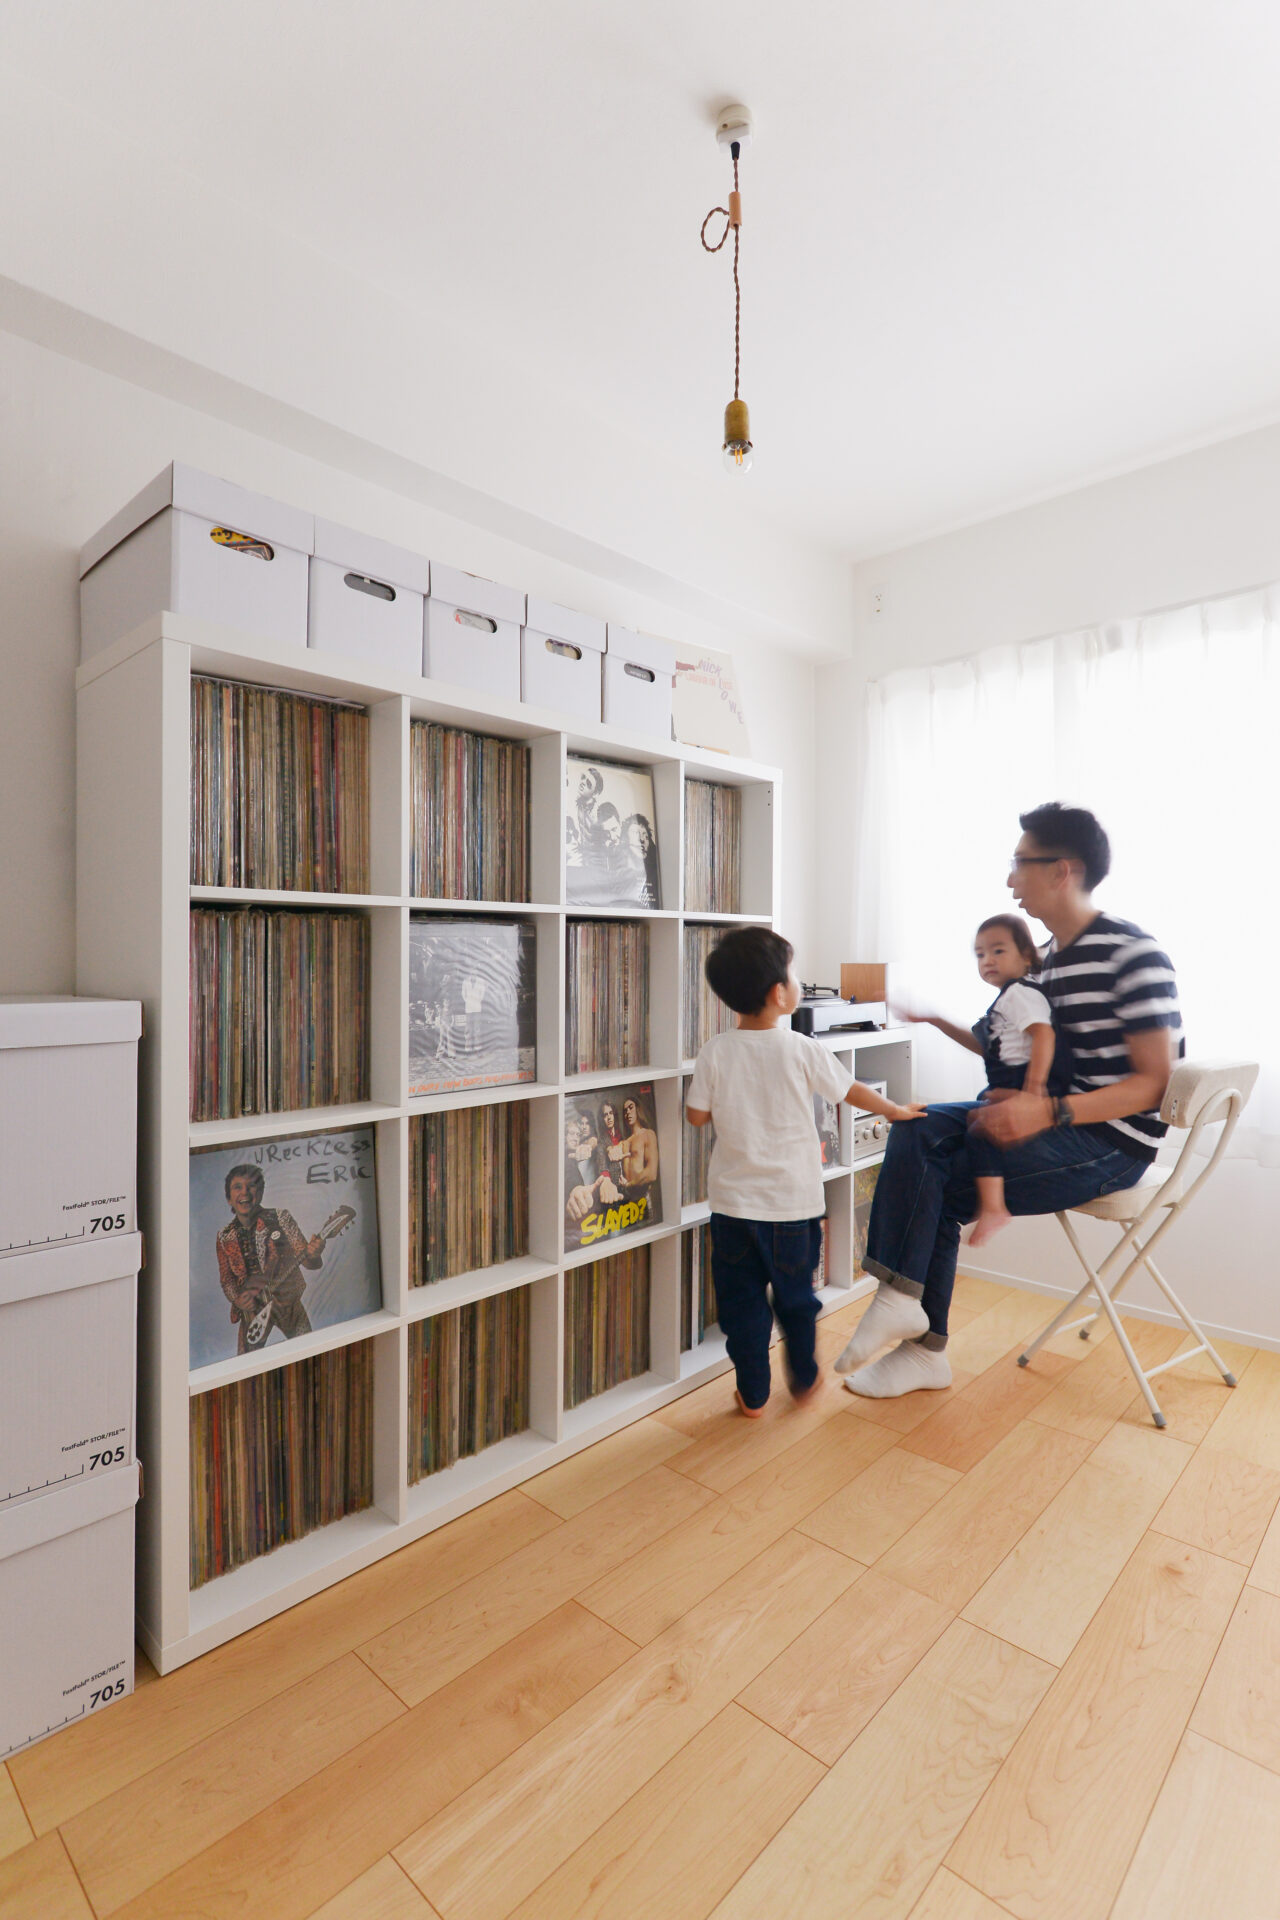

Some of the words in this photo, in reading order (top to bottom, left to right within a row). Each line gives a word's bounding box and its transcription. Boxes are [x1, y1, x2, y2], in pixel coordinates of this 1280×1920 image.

[90, 1214, 126, 1233] 705
[580, 1197, 648, 1245] SLAYED?
[89, 1446, 125, 1471] 705
[90, 1678, 125, 1708] 705
